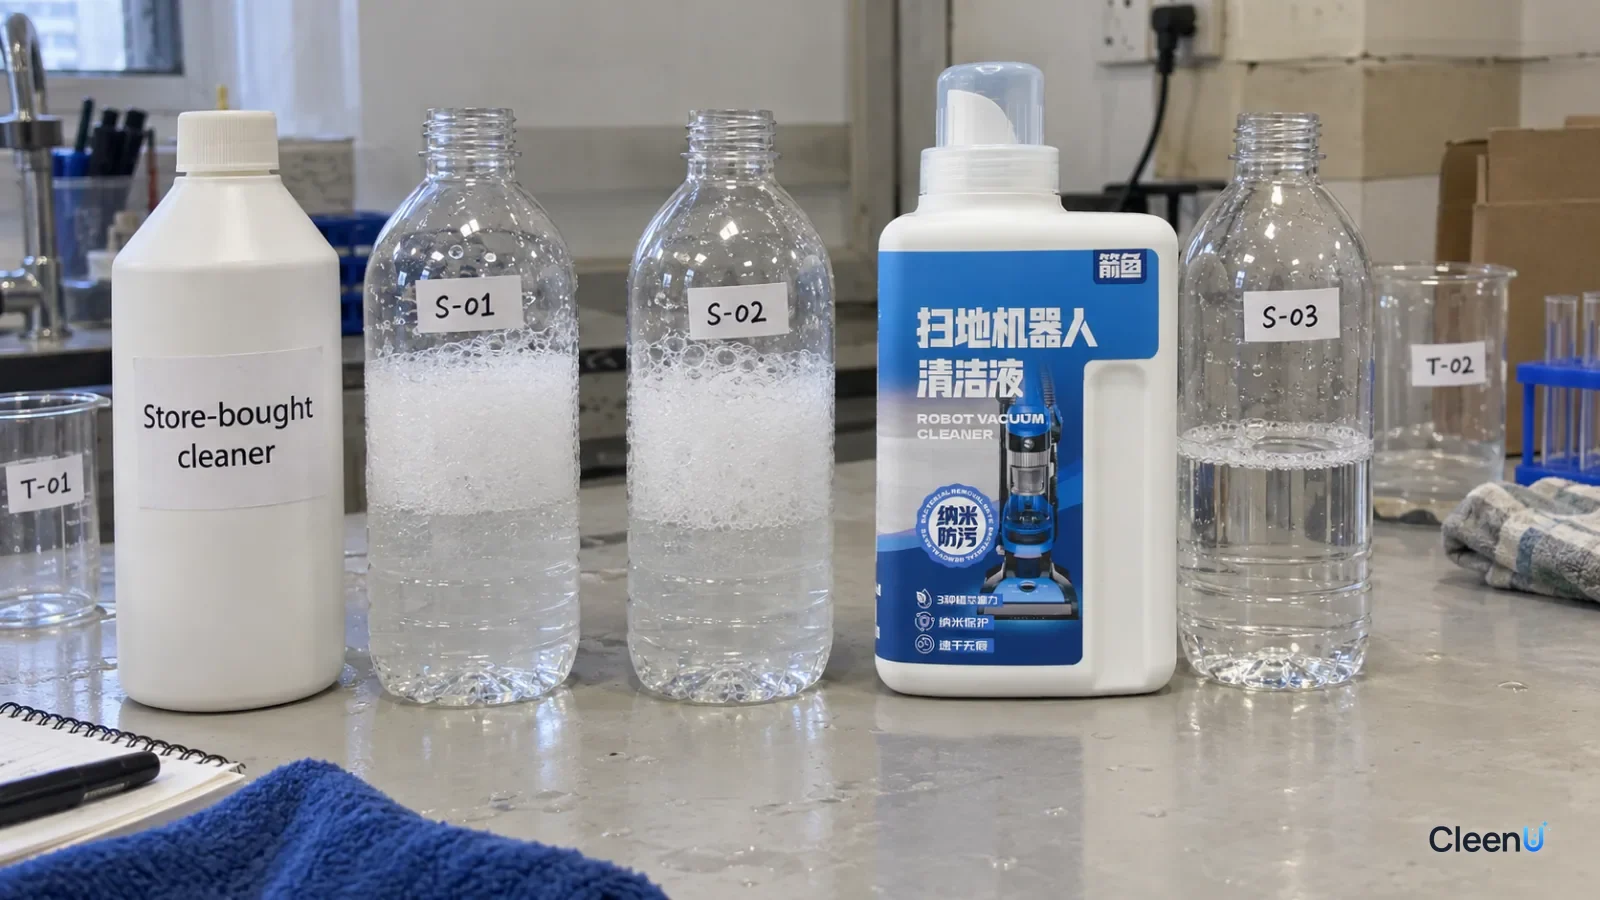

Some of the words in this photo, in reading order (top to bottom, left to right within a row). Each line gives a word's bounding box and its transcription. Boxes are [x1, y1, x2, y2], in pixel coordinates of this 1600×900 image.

[1098, 253, 1142, 279] 箭鱼
[435, 292, 496, 319] S-01
[706, 300, 767, 326] S-02
[1262, 304, 1319, 329] S-03
[916, 307, 1098, 349] 扫地机器人
[916, 358, 1024, 398] 清洁液
[1426, 356, 1475, 376] T-02
[143, 395, 314, 430] Store-bought
[916, 413, 974, 425] ROBOT
[980, 412, 1045, 425] VACUUM
[916, 428, 993, 440] CLEANER
[177, 443, 275, 469] cleaner
[20, 472, 72, 499] T-01
[936, 505, 979, 526] 纳米
[937, 526, 978, 549] 防污
[938, 616, 989, 629] 纳米保护
[938, 640, 988, 652] 速干无痕
